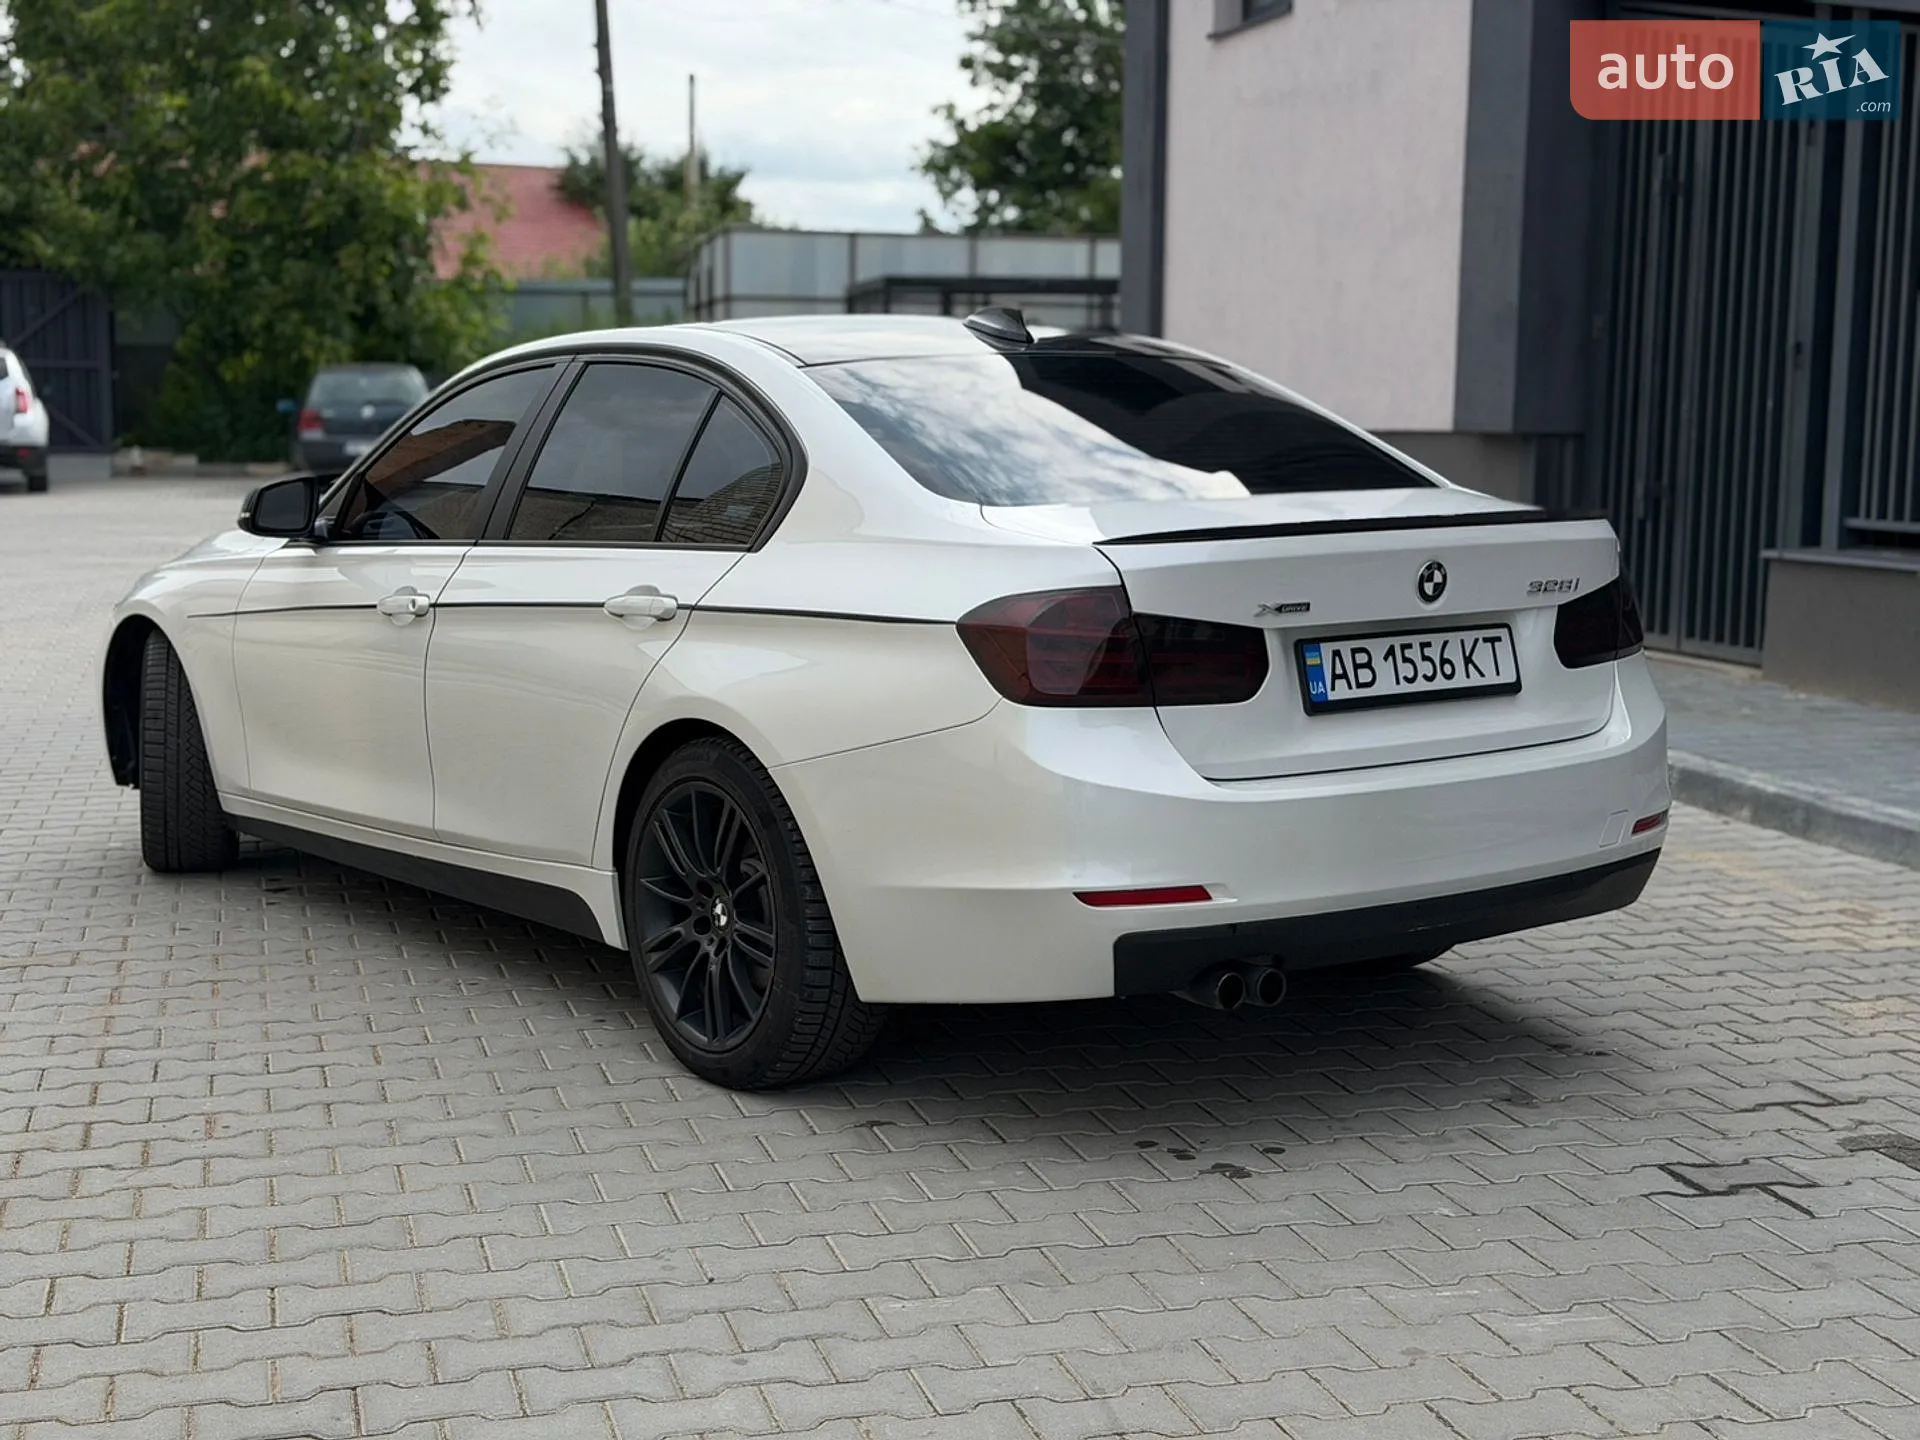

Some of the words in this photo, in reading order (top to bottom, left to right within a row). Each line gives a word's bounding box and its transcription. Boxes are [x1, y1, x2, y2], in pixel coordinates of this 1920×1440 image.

[1330, 647, 1377, 691] AB
[1383, 640, 1456, 685] 1556
[1460, 636, 1503, 679] KT
[1309, 680, 1326, 694] UA
